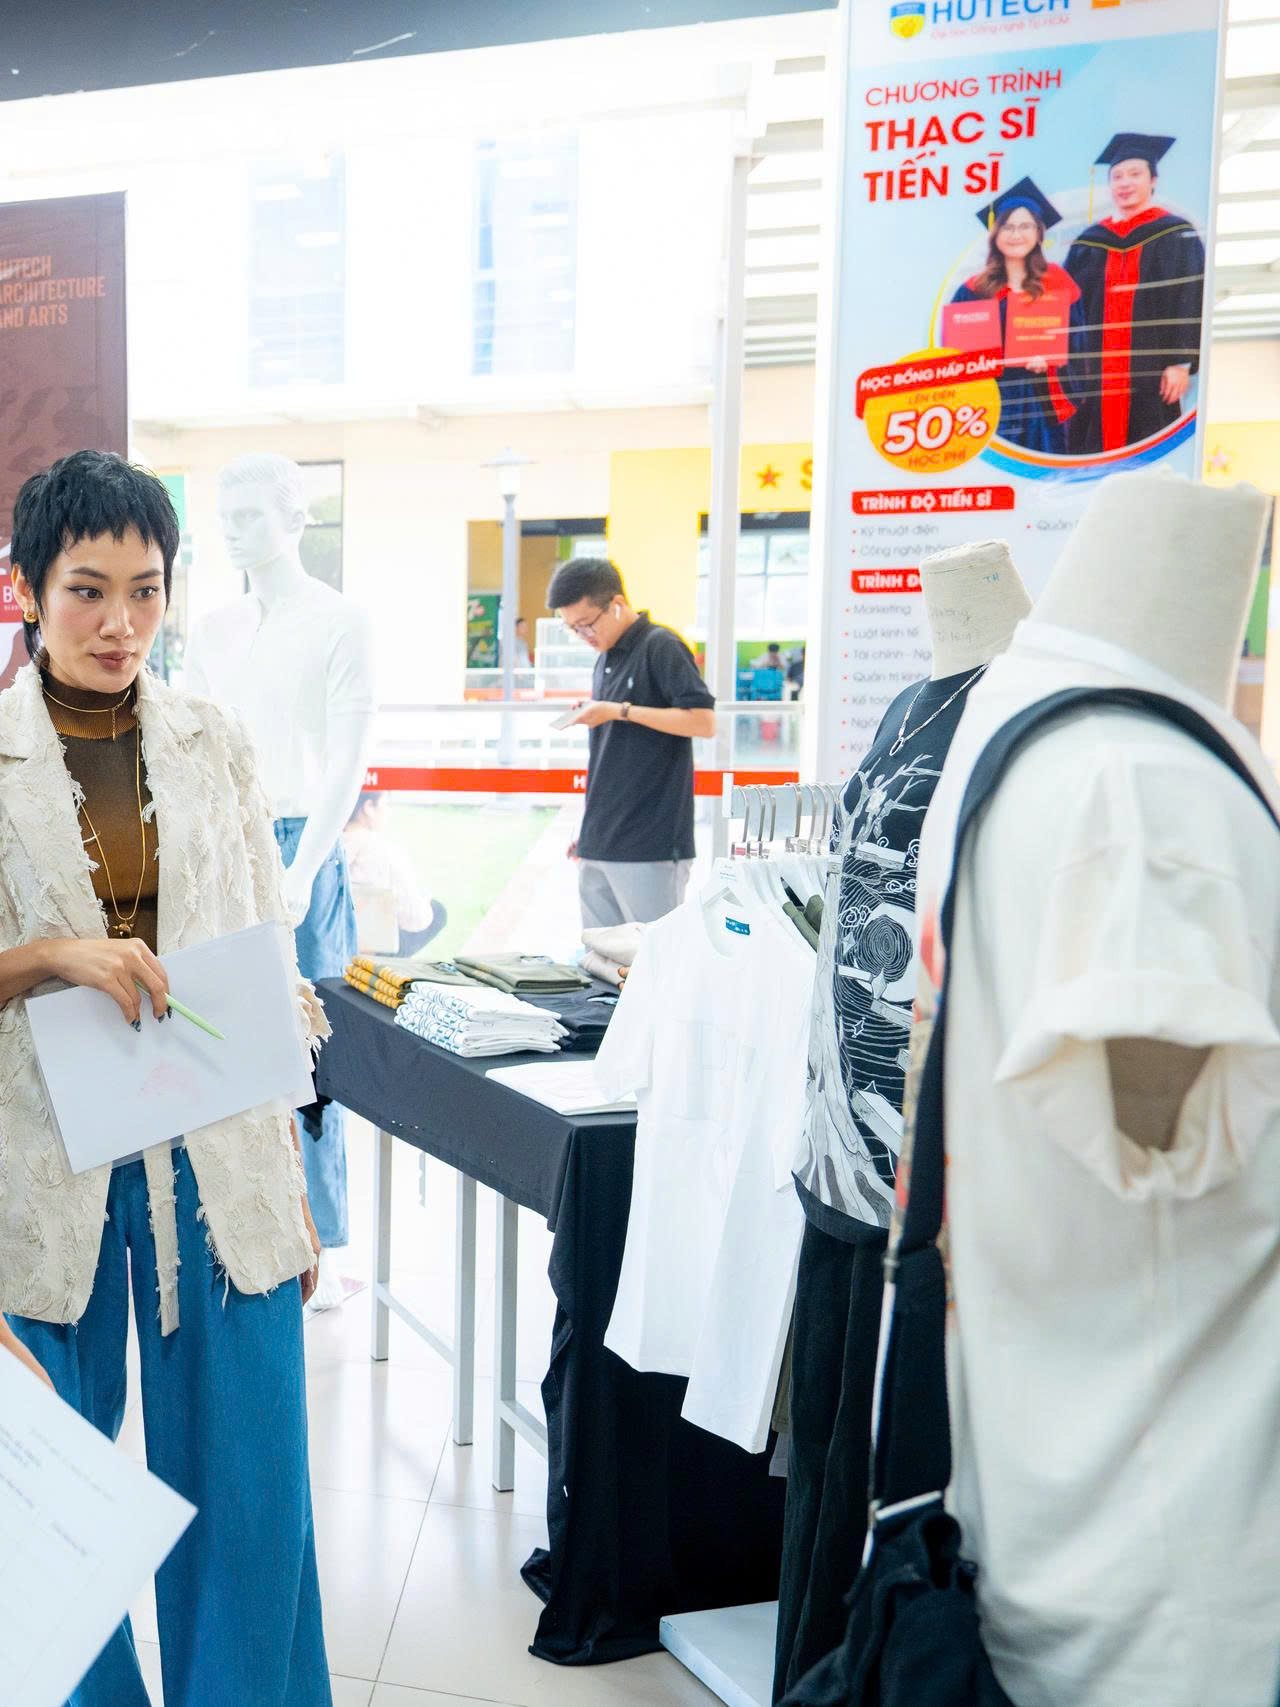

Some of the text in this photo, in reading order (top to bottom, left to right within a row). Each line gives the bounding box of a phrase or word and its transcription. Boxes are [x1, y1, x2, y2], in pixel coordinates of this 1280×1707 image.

[865, 67, 1062, 107] CHƯƠNG TRÌNH
[864, 97, 1040, 155] THẠC SĨ
[863, 152, 1004, 203] TIẾN SĨ
[28, 303, 68, 327] ARTS
[859, 376, 891, 392] HỌC
[881, 404, 988, 456] 50%
[908, 448, 967, 468] HỌC PHÍ
[861, 494, 906, 512] TRÌNH
[910, 494, 936, 512] ĐỘ
[939, 490, 973, 508] TIẾN
[857, 572, 920, 590] TRÌNH Đ
[853, 604, 911, 617] Marketing
[881, 627, 904, 639] kinh
